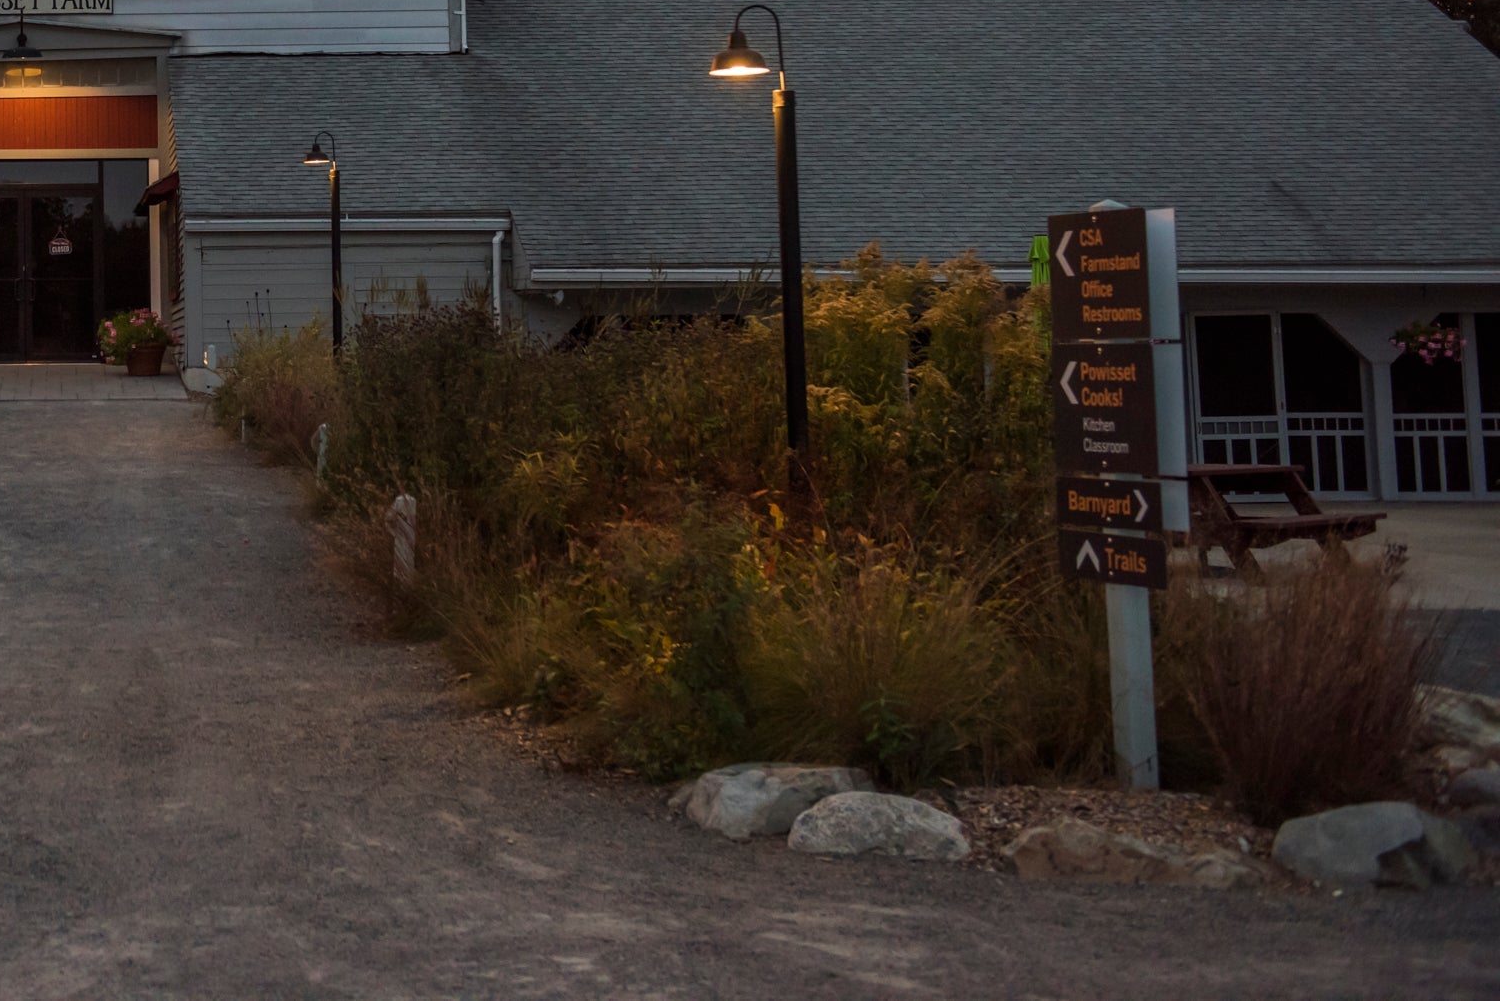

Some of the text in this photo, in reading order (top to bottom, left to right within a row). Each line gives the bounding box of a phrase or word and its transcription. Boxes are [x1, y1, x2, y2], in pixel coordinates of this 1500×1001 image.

[1079, 229, 1103, 247] CSA
[1080, 252, 1140, 272] Farmstand
[1081, 280, 1113, 298] Office
[1082, 305, 1143, 323] Restrooms
[1080, 361, 1137, 382] Powisset
[1081, 388, 1123, 407] Cooks!
[1082, 417, 1115, 432] Kitchen
[1083, 438, 1129, 454] Classroom
[1067, 490, 1131, 517] Barnyard
[1104, 548, 1147, 574] Trails
